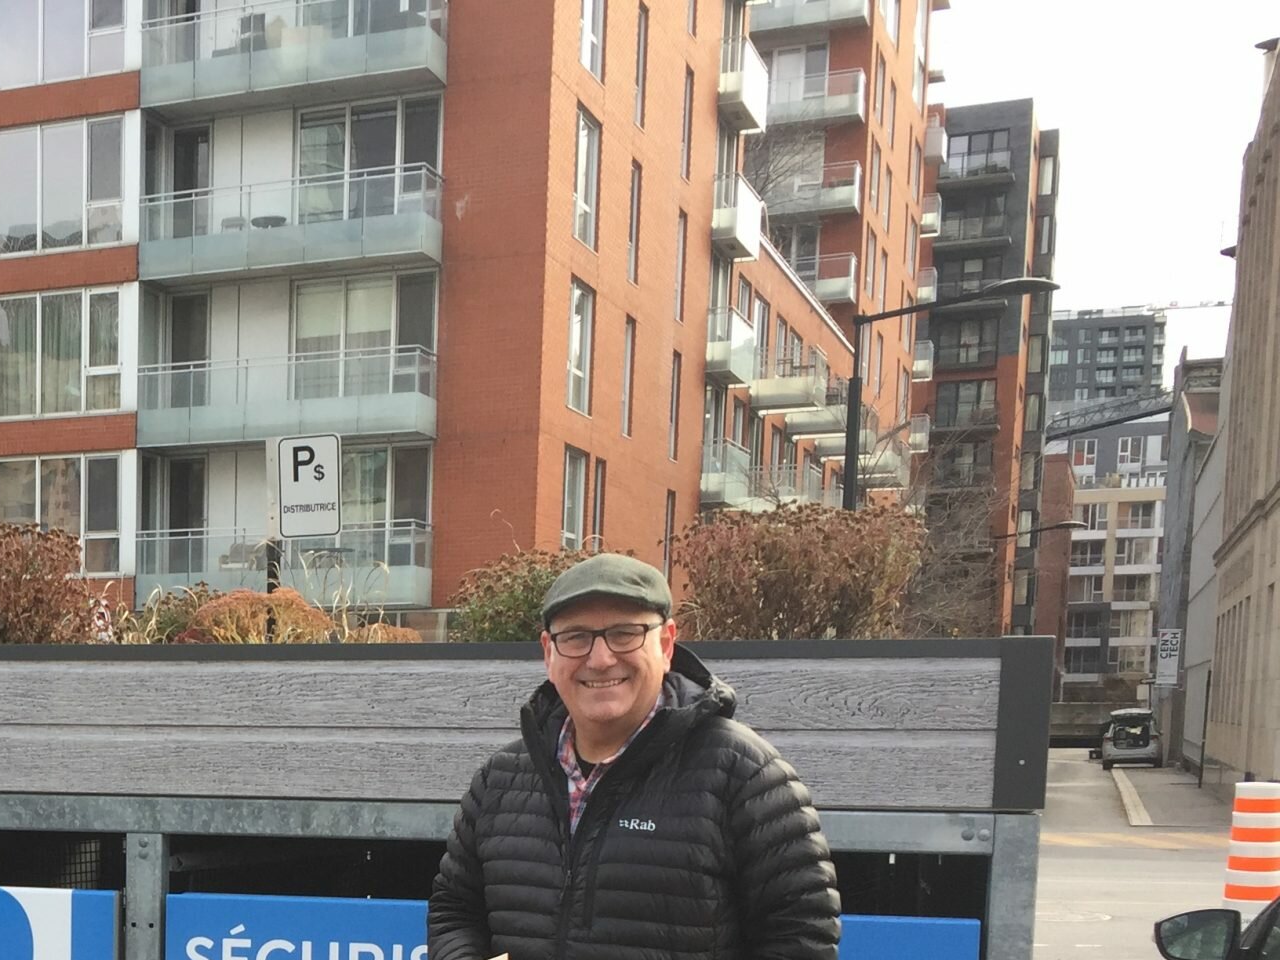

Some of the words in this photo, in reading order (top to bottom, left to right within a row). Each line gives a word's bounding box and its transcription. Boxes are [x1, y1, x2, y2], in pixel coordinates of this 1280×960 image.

[283, 502, 337, 514] DISTRIBUTRICE
[1160, 639, 1170, 659] CEN
[1169, 632, 1180, 659] TECH
[629, 818, 656, 831] Rab
